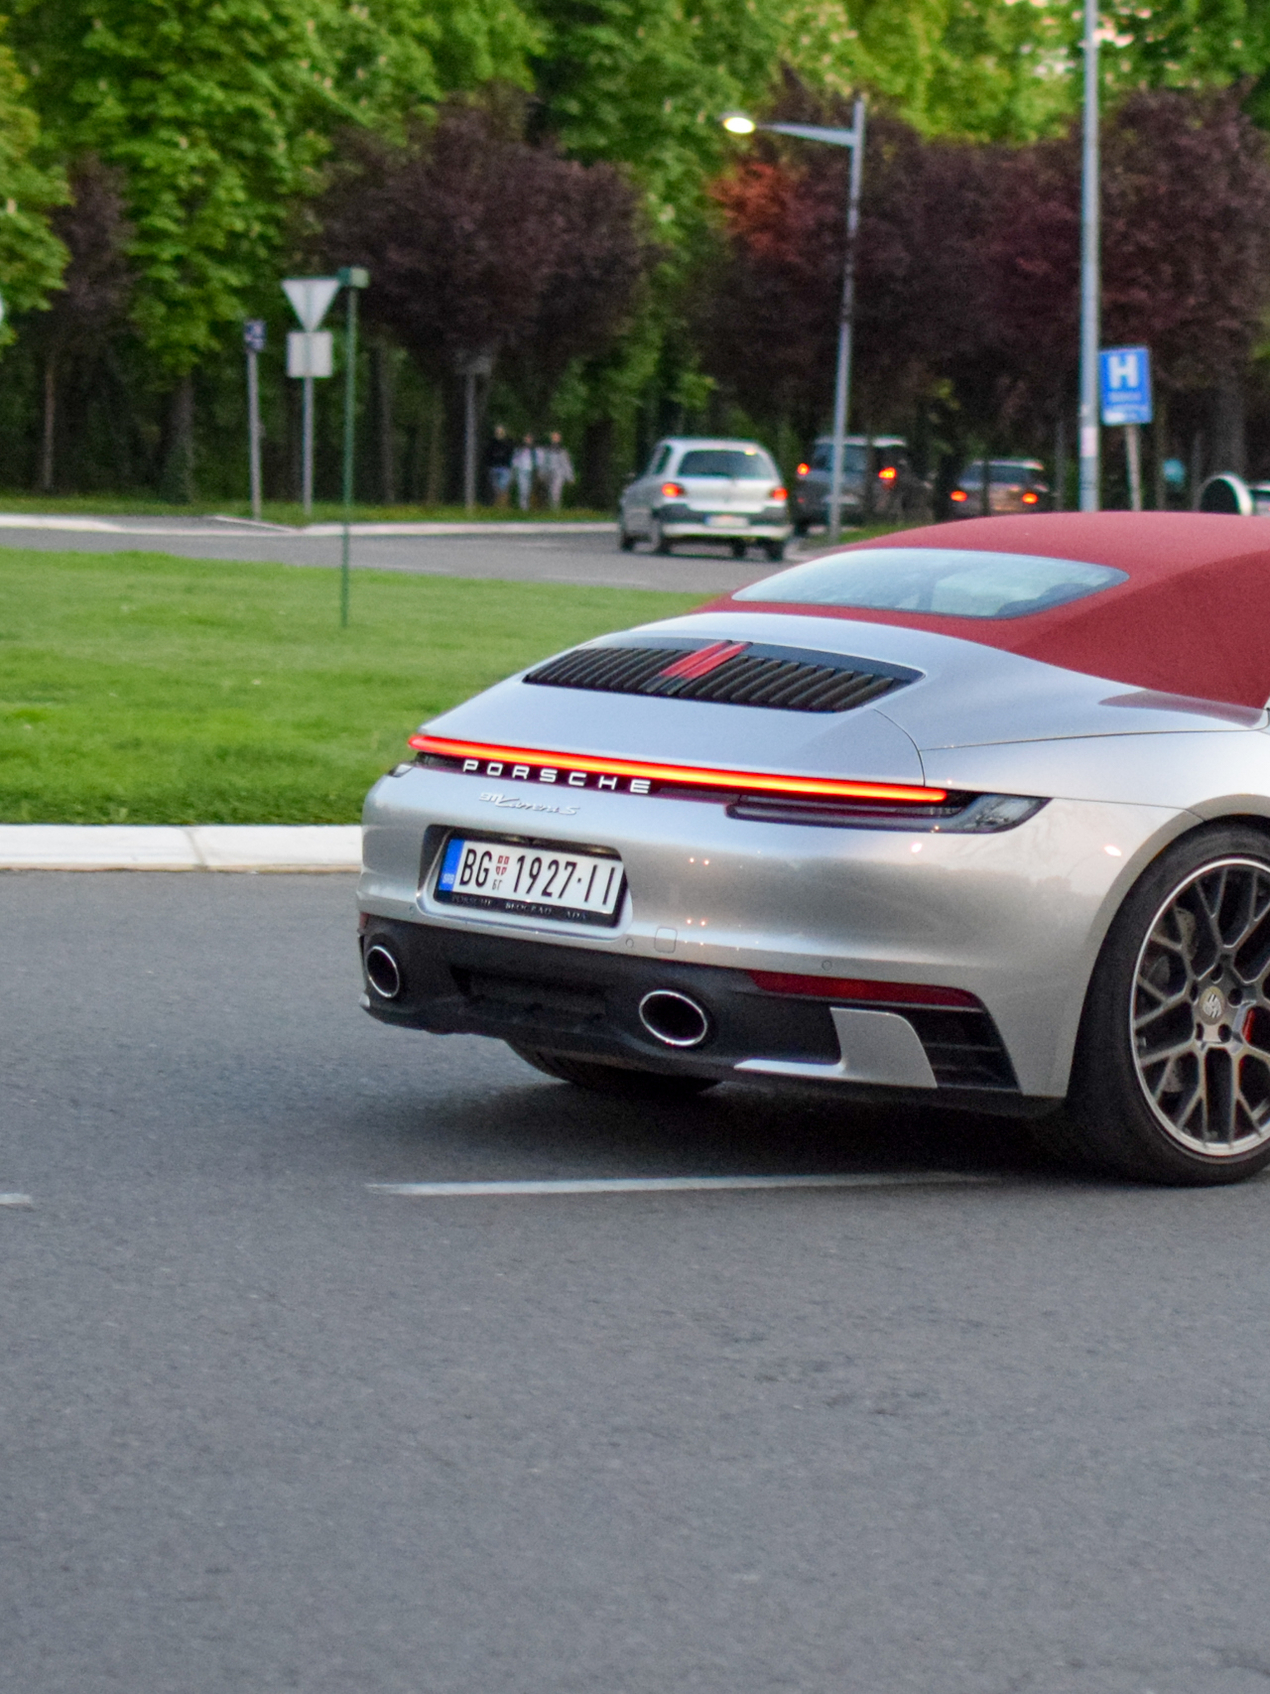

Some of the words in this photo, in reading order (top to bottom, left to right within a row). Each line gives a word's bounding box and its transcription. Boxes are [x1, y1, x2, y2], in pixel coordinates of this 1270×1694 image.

[1109, 354, 1138, 388] H
[463, 759, 651, 794] PORSCHE
[560, 806, 581, 816] S
[459, 848, 493, 888] BG
